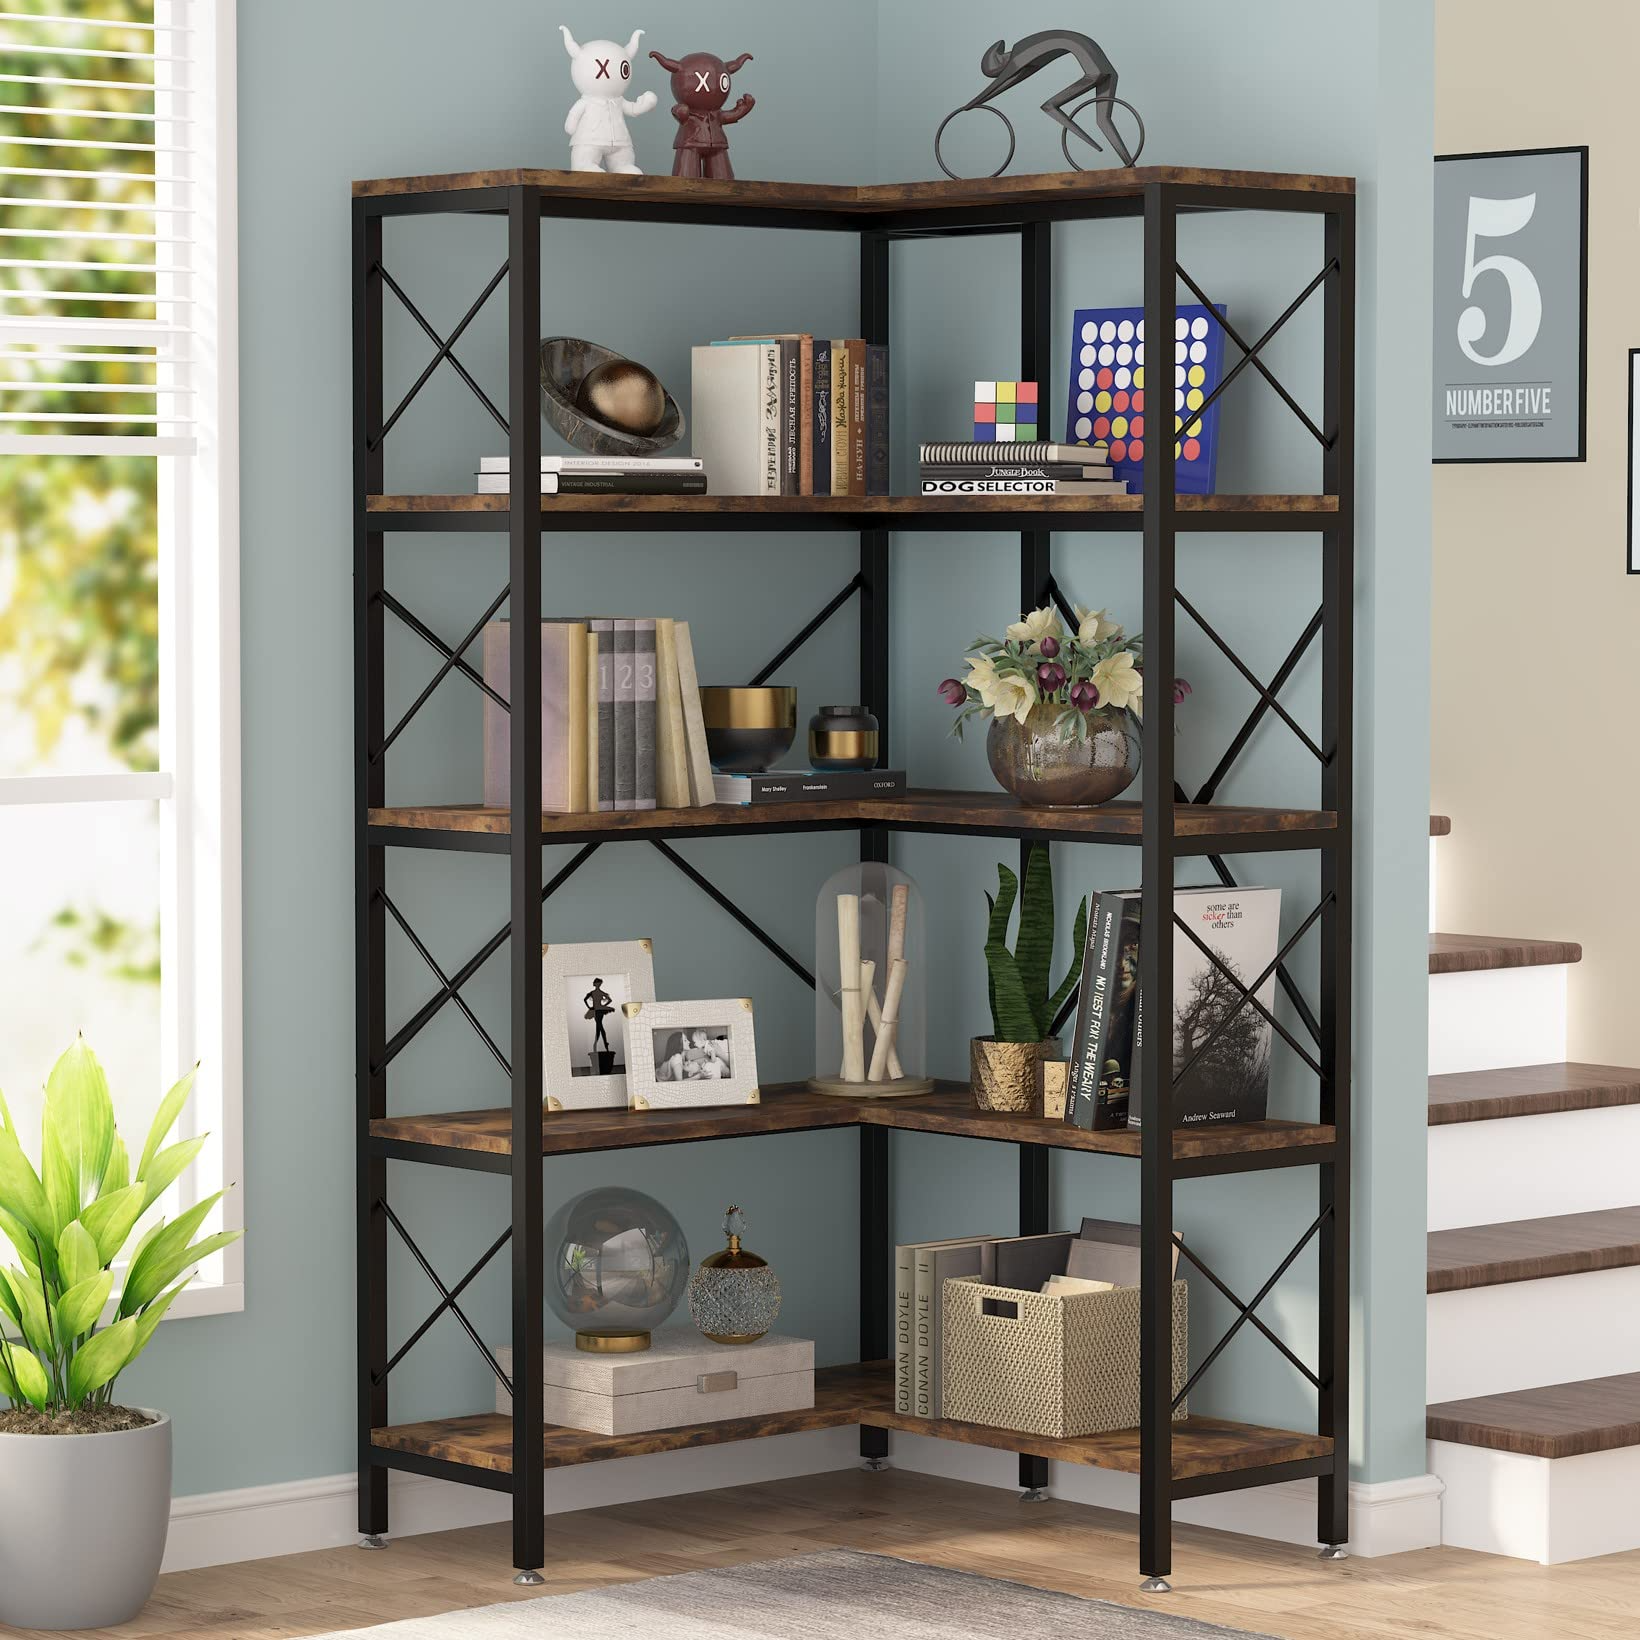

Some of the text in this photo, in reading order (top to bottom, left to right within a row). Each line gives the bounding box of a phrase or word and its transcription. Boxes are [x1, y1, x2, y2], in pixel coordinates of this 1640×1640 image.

[1457, 192, 1542, 366] 5
[835, 391, 847, 428] Жажда
[922, 481, 1055, 492] DOG SELECTOR
[600, 666, 608, 690] 1
[619, 665, 633, 689] 2
[640, 665, 653, 688] 3
[1202, 910, 1243, 921] sicker than
[1206, 904, 1227, 912] some
[1211, 920, 1235, 929] others
[1079, 975, 1106, 1100] NO REST FOR THE WEARY
[1182, 1109, 1236, 1123] Andrew Seaward
[899, 1291, 909, 1344] DOYLE
[918, 1295, 929, 1347] DOYLE
[899, 1353, 909, 1411] CONAN
[918, 1356, 929, 1415] CONAN
